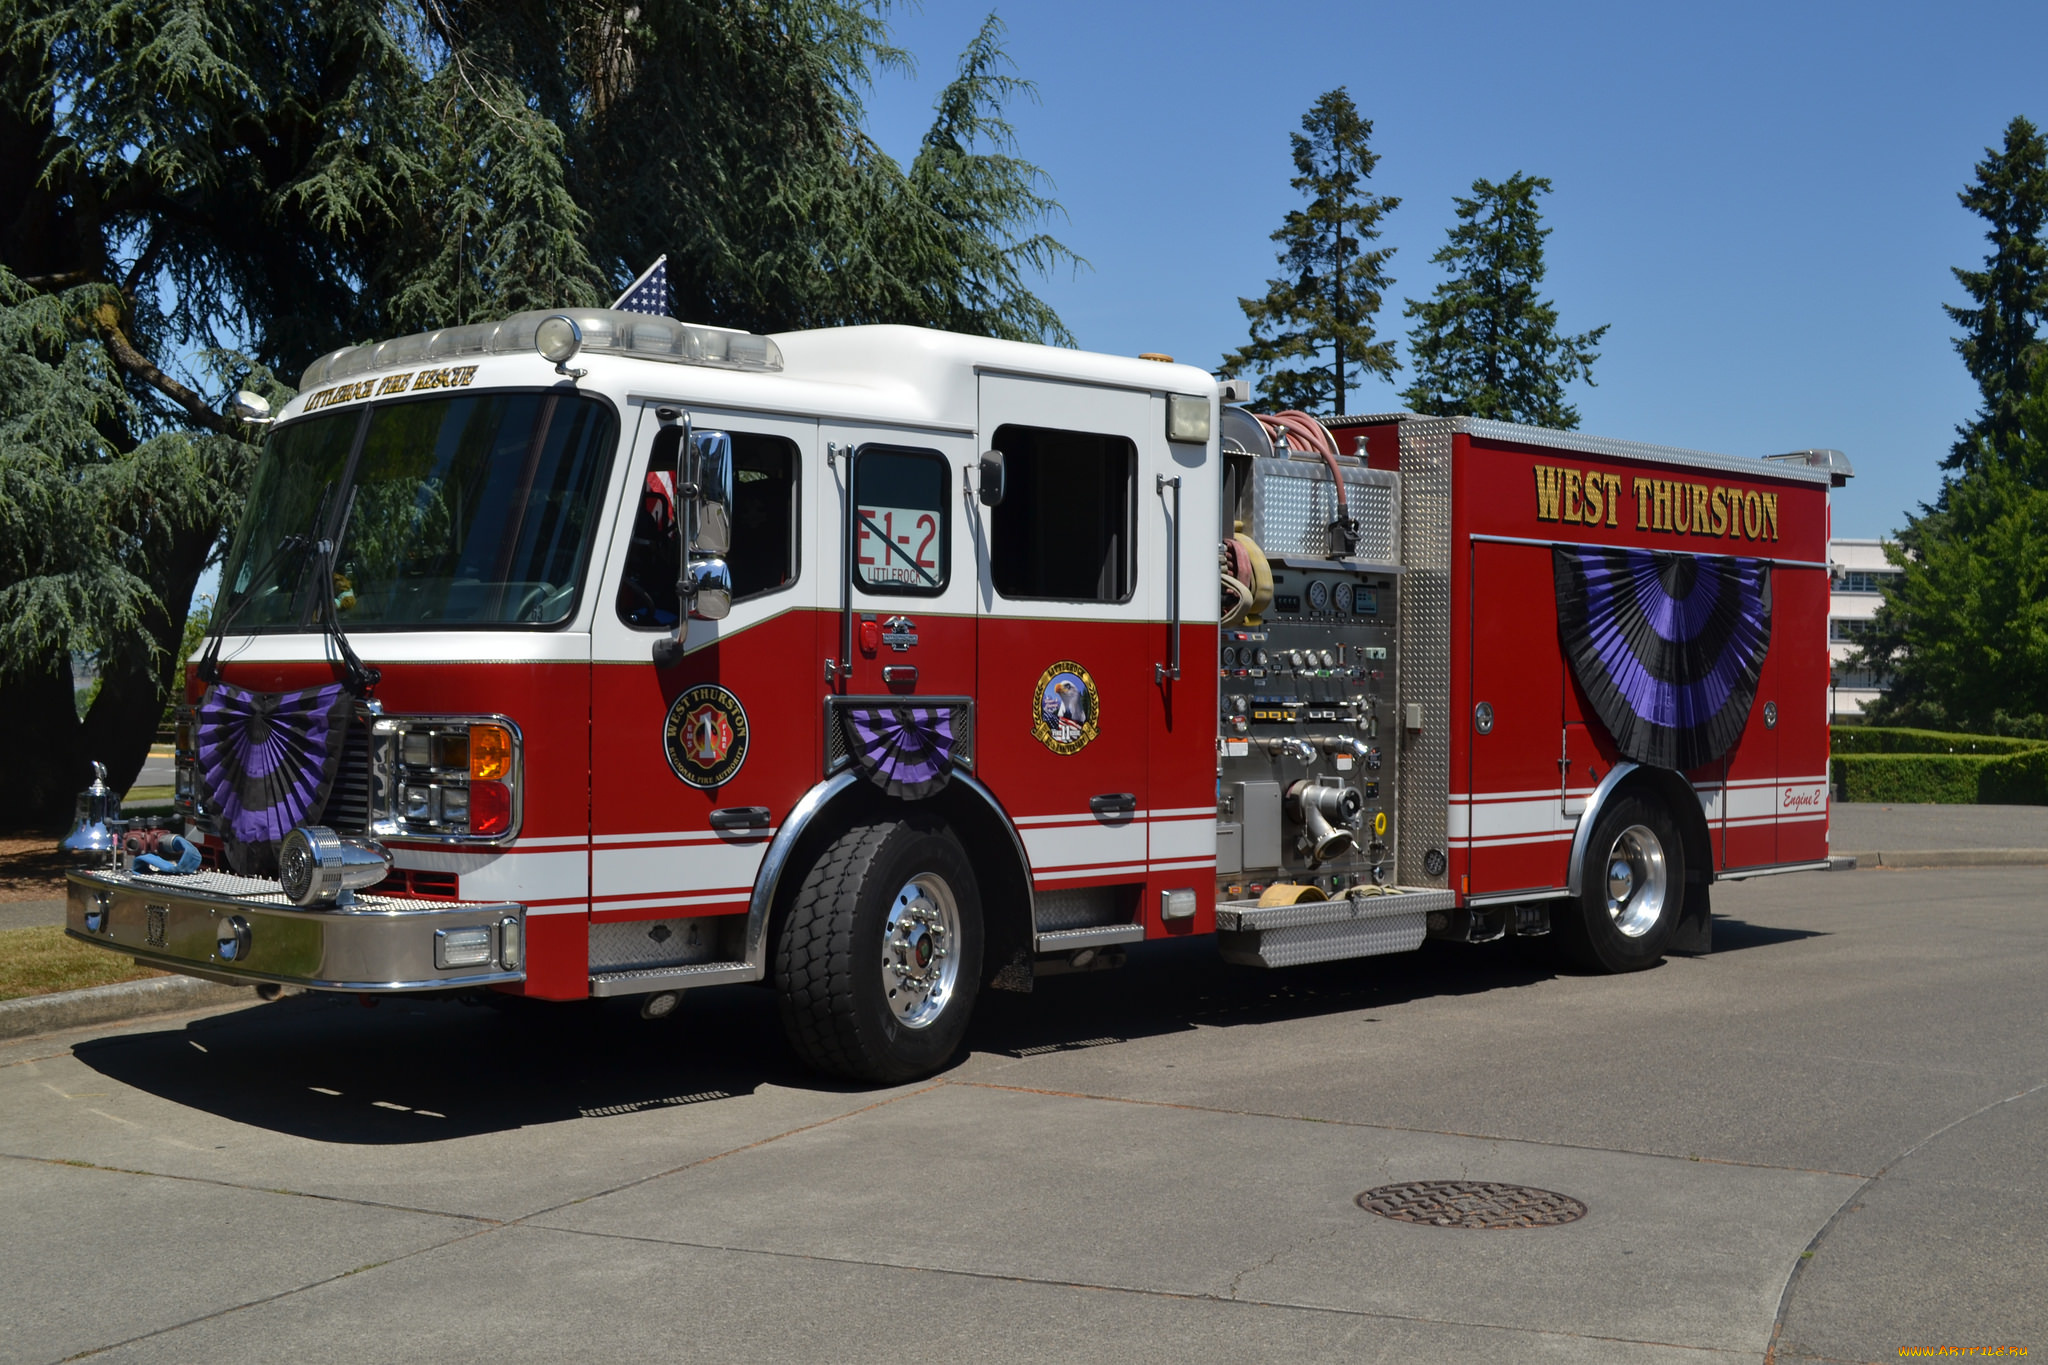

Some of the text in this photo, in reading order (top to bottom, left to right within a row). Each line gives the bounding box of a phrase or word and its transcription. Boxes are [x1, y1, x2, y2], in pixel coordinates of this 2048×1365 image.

[303, 365, 480, 413] LITTLEROCK FIRE RESCUE
[1533, 465, 1779, 542] WEST THURSTON
[857, 510, 936, 568] E1-2
[867, 567, 921, 583] LITTLEROCK
[1047, 662, 1086, 677] LITTLEROCK
[667, 688, 746, 737] WEST THURSTON
[699, 711, 716, 759] 1
[668, 745, 744, 784] REGIONAL FIRE AUTHORITY
[1783, 787, 1820, 812] Engine 2
